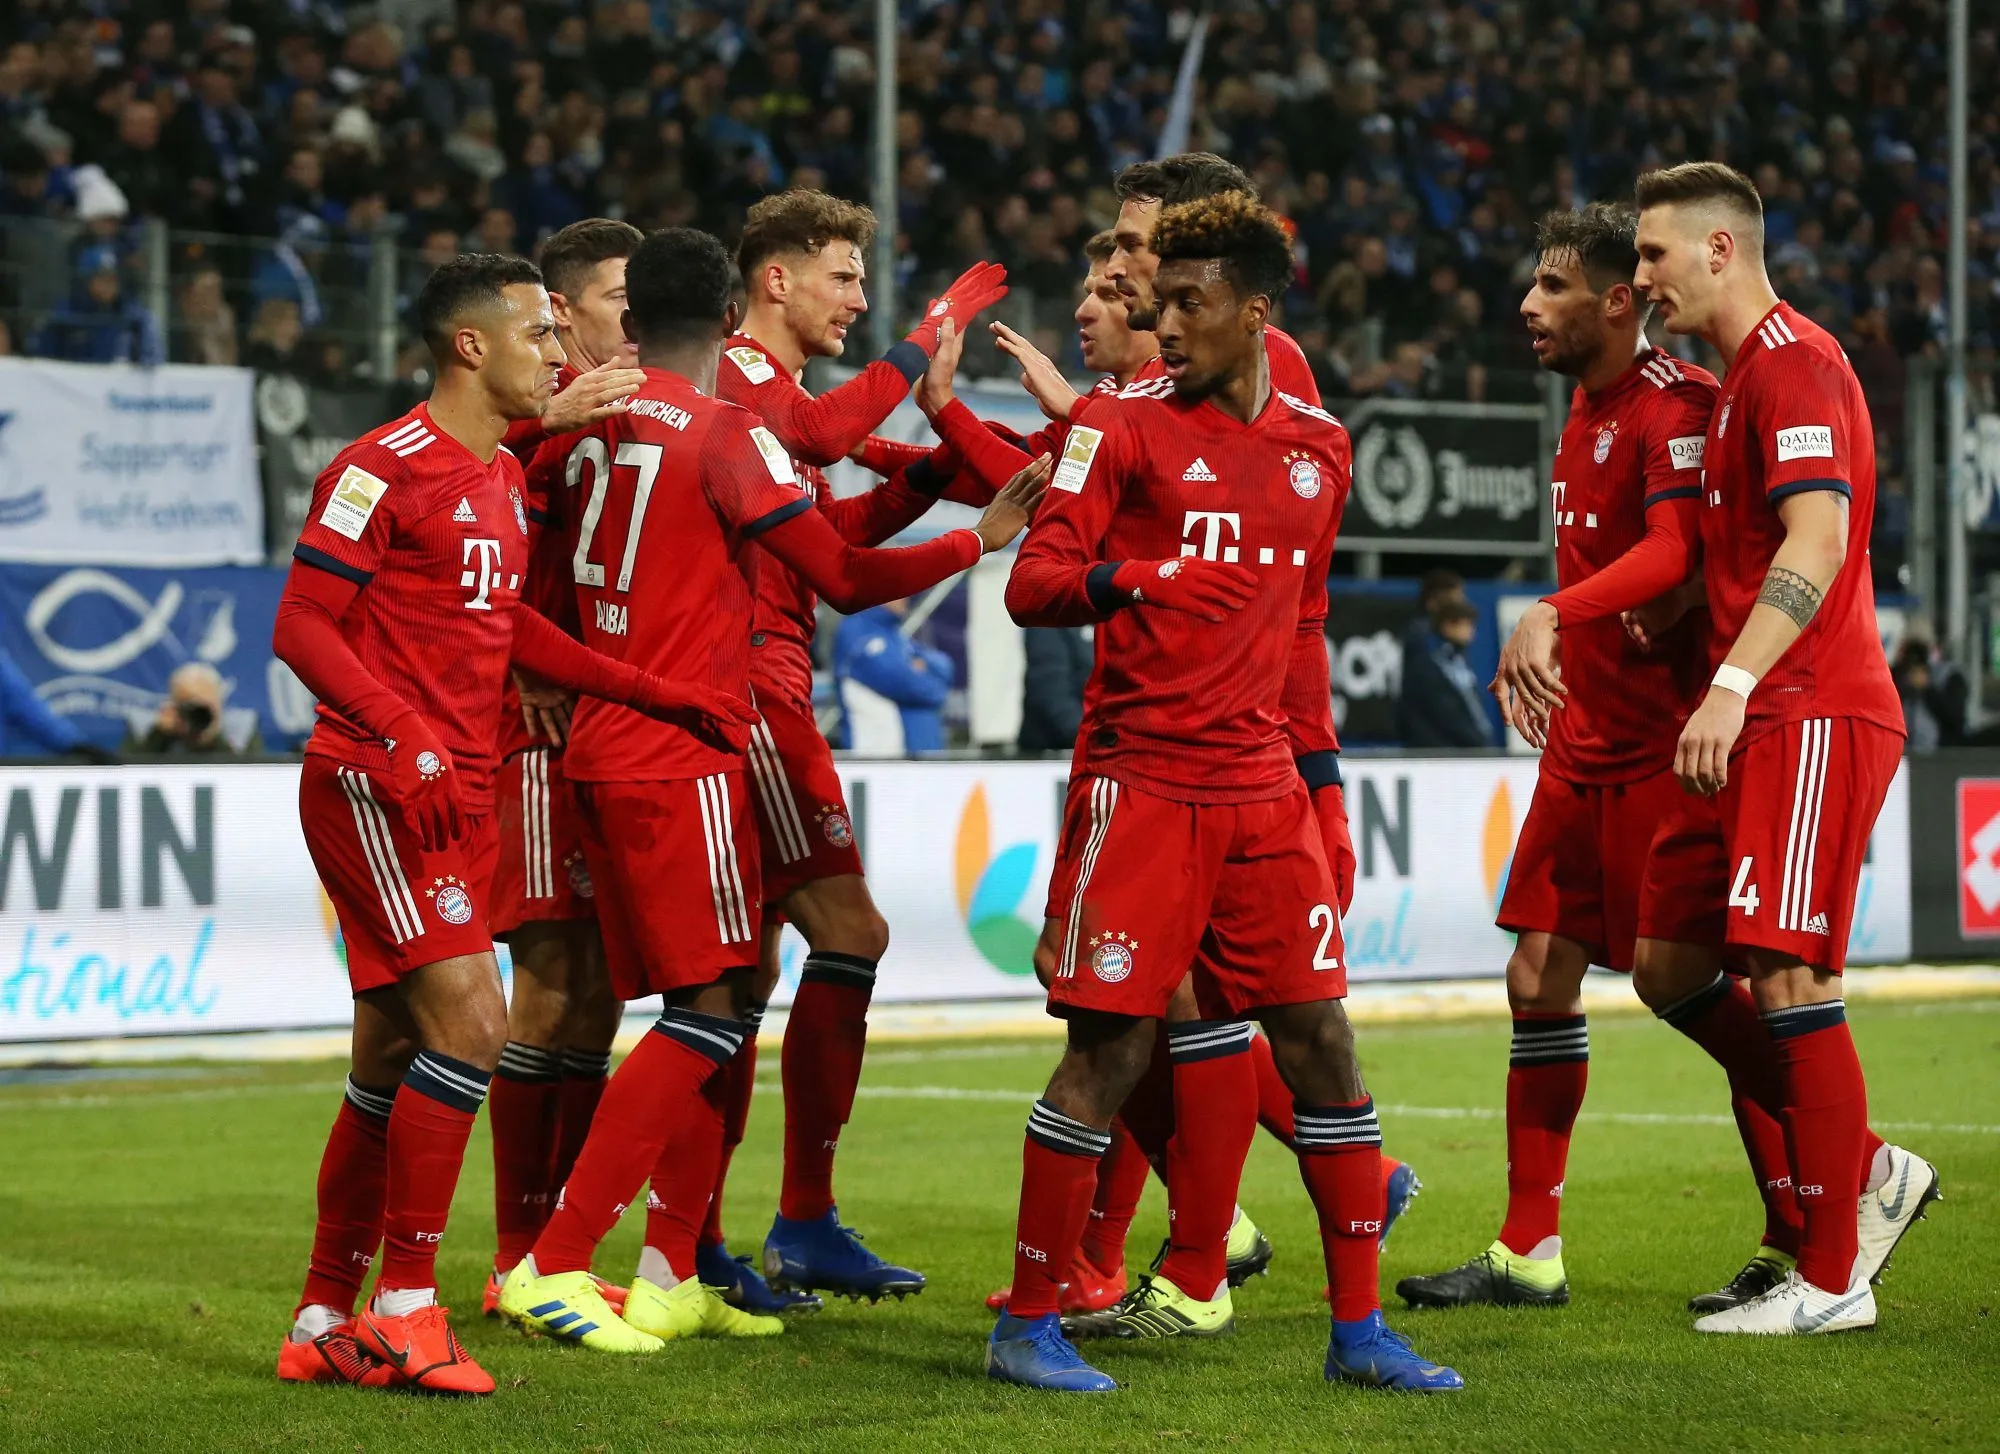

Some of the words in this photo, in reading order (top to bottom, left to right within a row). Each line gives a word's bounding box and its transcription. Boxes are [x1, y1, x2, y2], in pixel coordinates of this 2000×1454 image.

[1780, 432, 1829, 448] QATAR
[1793, 444, 1830, 452] AIRWAYS
[1182, 472, 1217, 482] adidas
[331, 498, 366, 519] BUNDESLIGA
[565, 436, 664, 592] 27
[453, 513, 478, 522] adidas
[0, 786, 214, 911] WIN
[442, 888, 467, 901] BAYERN
[1728, 856, 1760, 916] 4
[1308, 903, 1346, 971] 2
[1104, 945, 1130, 962] BAYERN
[1095, 965, 1128, 980] MÜNCHEN
[1018, 1240, 1047, 1262] FCB
